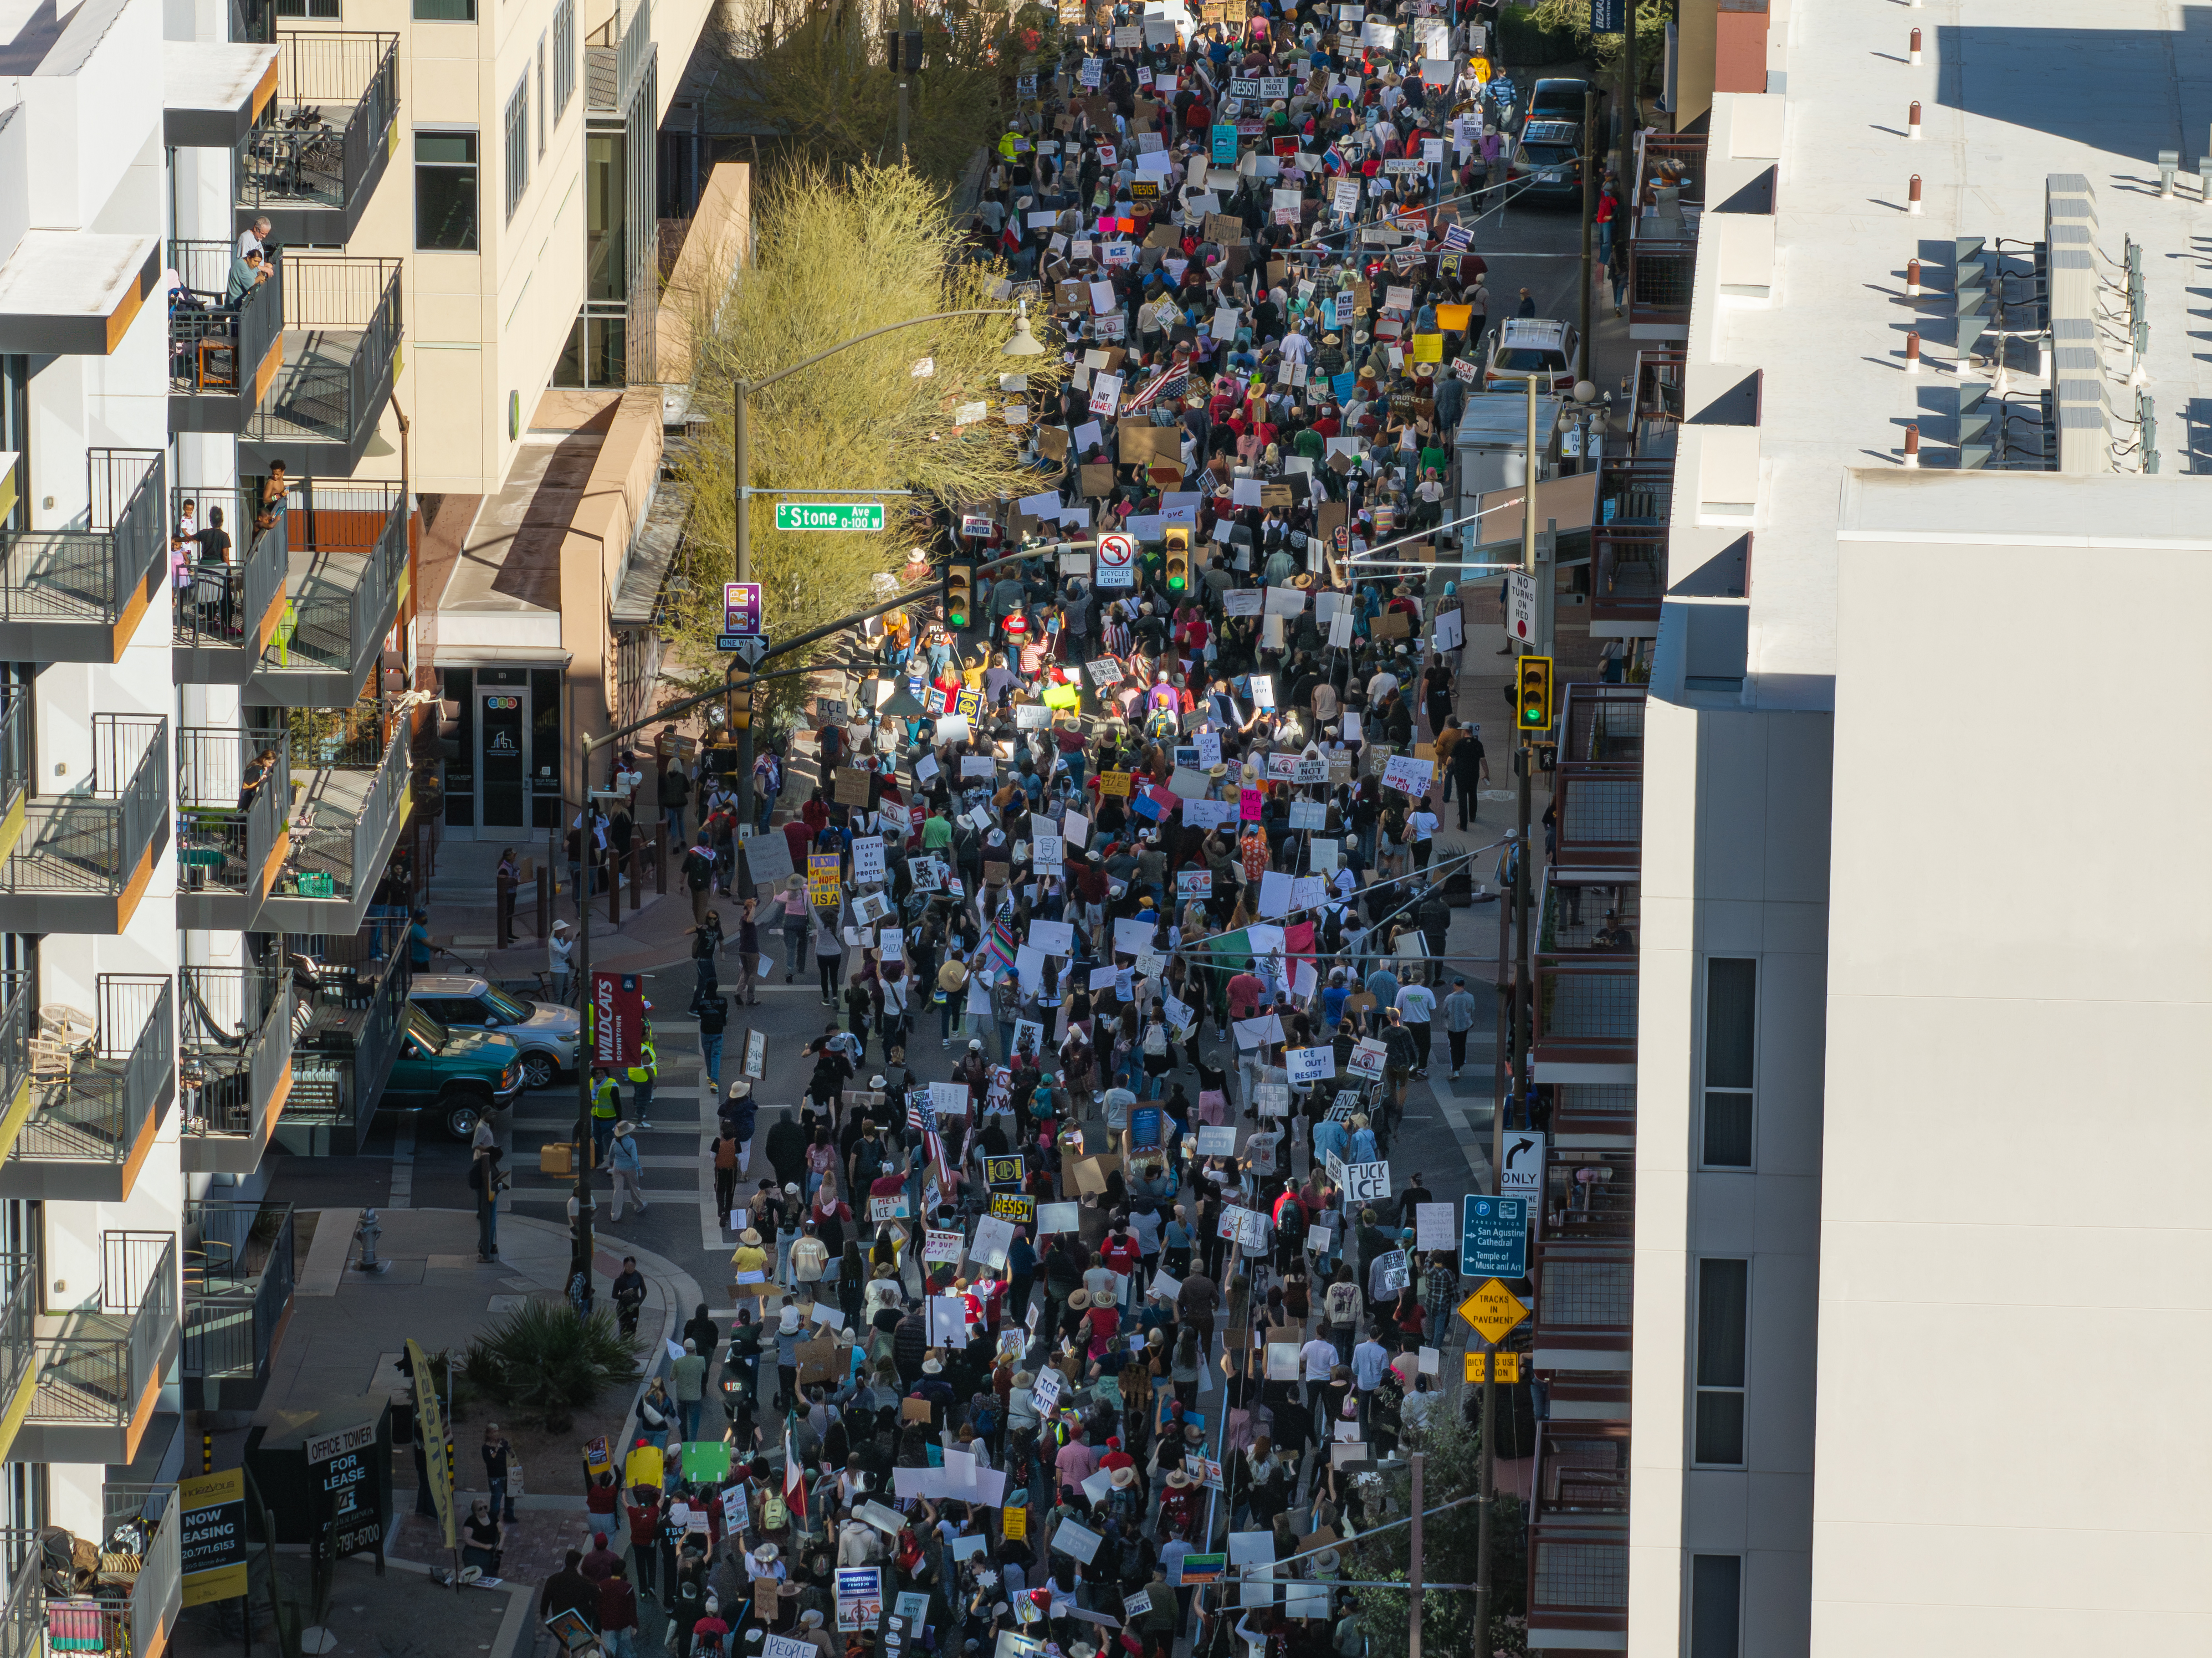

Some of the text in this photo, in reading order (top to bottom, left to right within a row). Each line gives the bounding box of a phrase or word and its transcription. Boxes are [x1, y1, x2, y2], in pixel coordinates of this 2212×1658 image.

[1232, 80, 1257, 96] RESIST
[1133, 184, 1156, 196] RESIST
[1110, 247, 1127, 256] ICE
[1338, 295, 1353, 304] ICE
[1455, 360, 1474, 373] FUCK
[1456, 369, 1473, 381] RUMP
[1097, 391, 1110, 402] NOT
[1391, 394, 1426, 404] PROTECT
[1090, 399, 1113, 412] POWER
[1571, 434, 1593, 442] TUS
[780, 506, 870, 526] S Stone Ave
[841, 518, 880, 528] 0-100 W
[1517, 576, 1528, 589] NO
[1511, 586, 1534, 602] TURNS
[1517, 600, 1527, 610] ON
[1515, 608, 1529, 621] RED
[820, 700, 842, 713] ICE
[1018, 707, 1048, 718] ABOLISH
[1242, 805, 1261, 816] ICE
[818, 876, 839, 884] HOPE
[811, 894, 839, 905] USA
[883, 943, 901, 953] RAZA
[598, 979, 612, 1062] WILDCATS
[1299, 1050, 1315, 1058] ICE
[1295, 1071, 1323, 1080] RESIST
[1334, 1093, 1358, 1106] END
[1327, 1107, 1353, 1122] ICE
[1348, 1161, 1385, 1181] FUCK
[1502, 1173, 1537, 1184] ONLY
[878, 1196, 902, 1205] MELT
[875, 1206, 889, 1218] ICE
[995, 1199, 1028, 1215] RESIST
[1493, 1229, 1525, 1238] Agustine
[1477, 1237, 1513, 1247] Cathedral
[974, 1250, 1002, 1266] SHAME
[1384, 1253, 1405, 1263] DEFEND
[1476, 1252, 1499, 1262] Temple
[1479, 1294, 1509, 1303] TRACKS
[1473, 1316, 1514, 1325] PAVEMENT
[1502, 1358, 1515, 1367] USE
[1475, 1369, 1508, 1377] CAION
[1041, 1378, 1058, 1396] ICE
[1034, 1393, 1054, 1415] OUT!
[311, 1428, 372, 1461] OFFICE TOWER
[330, 1454, 357, 1473] FOR
[324, 1466, 365, 1491] LEASE
[185, 1509, 222, 1527] NOW
[181, 1523, 234, 1544] EASING
[182, 1540, 235, 1559] 20.771.6153
